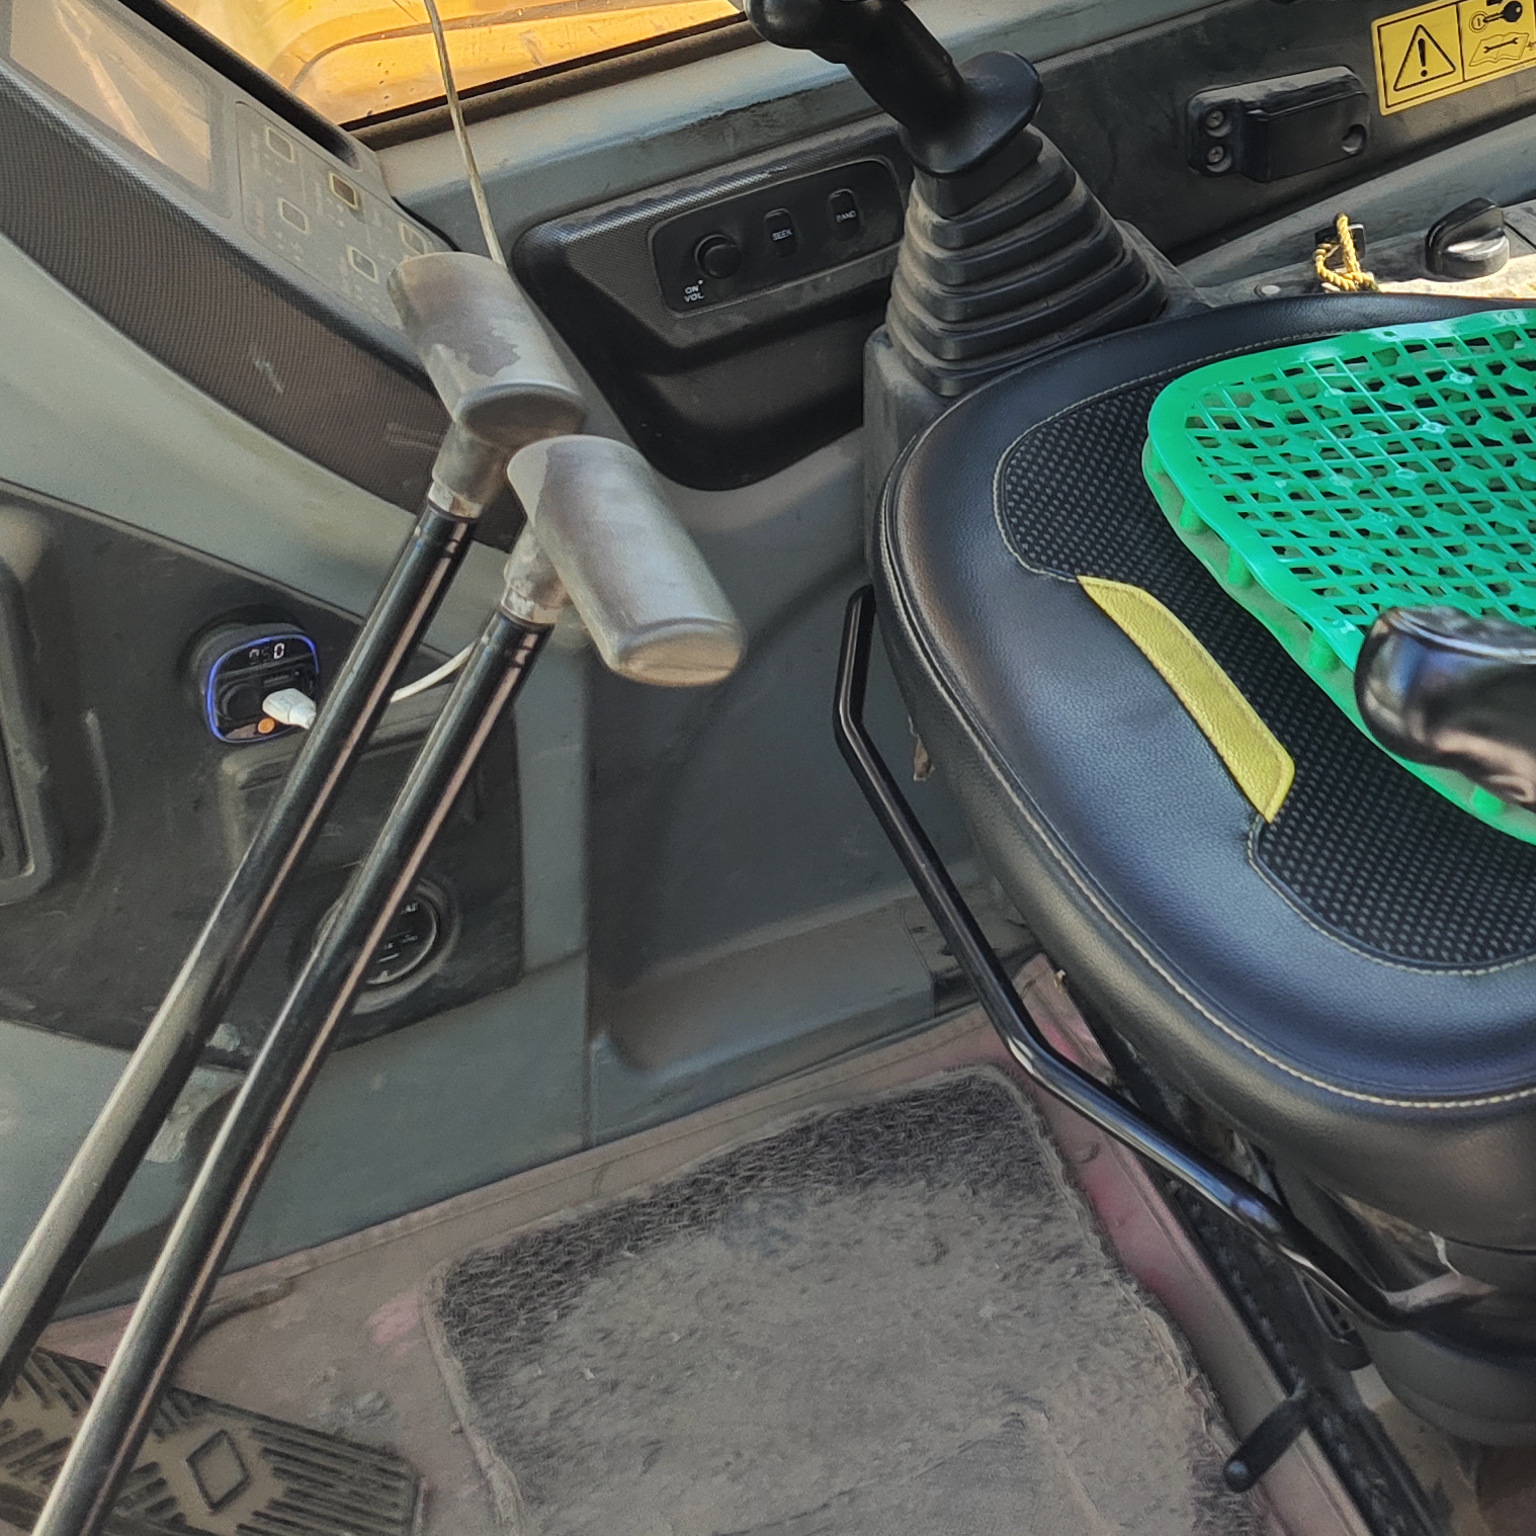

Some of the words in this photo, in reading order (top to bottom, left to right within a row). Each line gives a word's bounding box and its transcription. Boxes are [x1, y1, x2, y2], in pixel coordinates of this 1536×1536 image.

[772, 228, 793, 241] SEEK
[685, 285, 699, 294] ON
[684, 292, 705, 302] VOL
